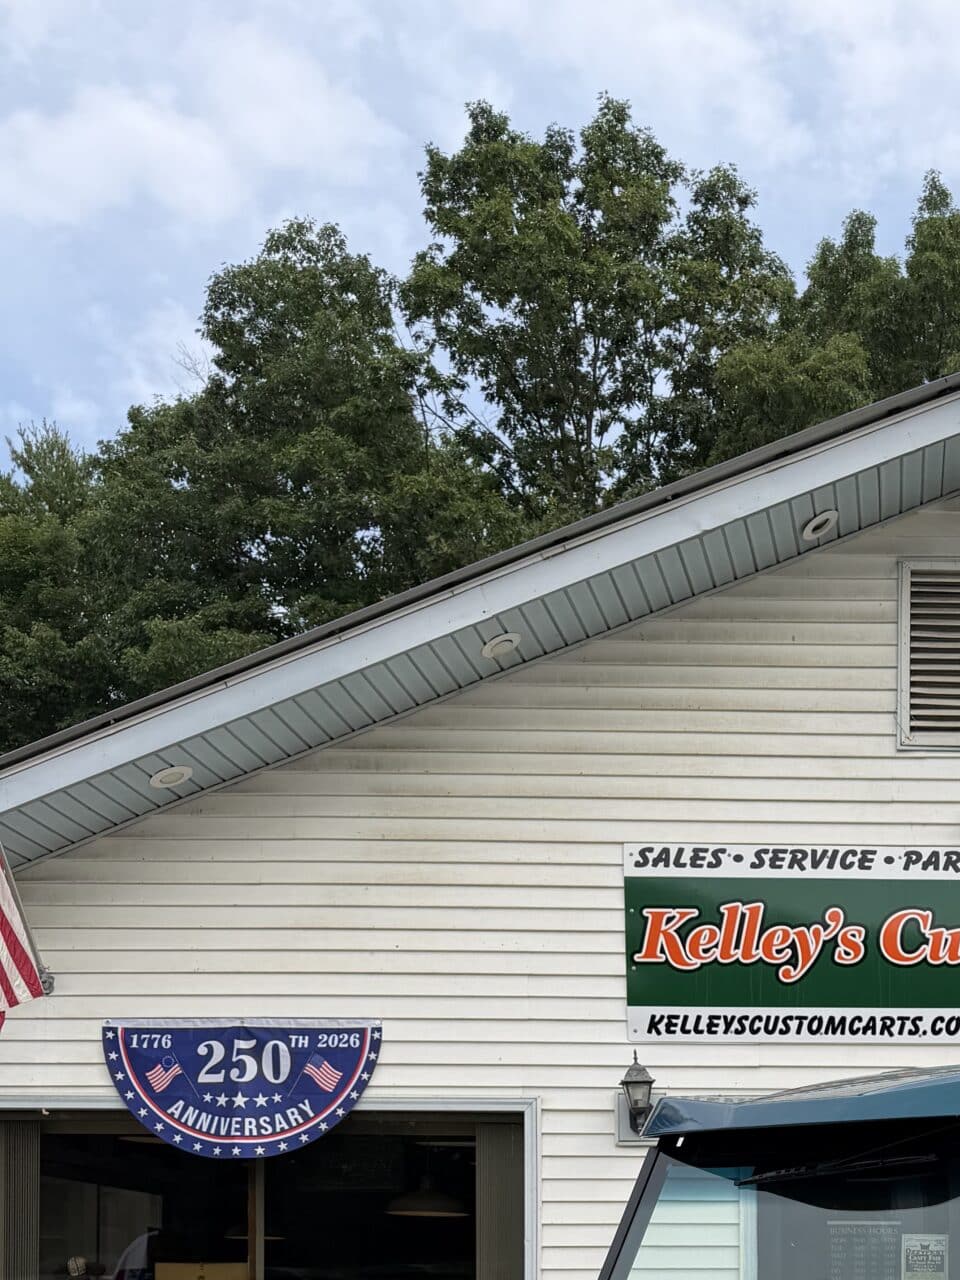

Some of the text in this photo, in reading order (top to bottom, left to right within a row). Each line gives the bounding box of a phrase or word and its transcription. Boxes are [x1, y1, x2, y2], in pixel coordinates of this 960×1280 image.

[634, 847, 727, 869] SALES
[749, 848, 877, 871] SERVICE
[633, 902, 865, 983] Kelley's
[129, 1034, 172, 1049] 1776
[317, 1033, 360, 1048] 2026
[166, 1100, 316, 1137] ANNIVERSARY
